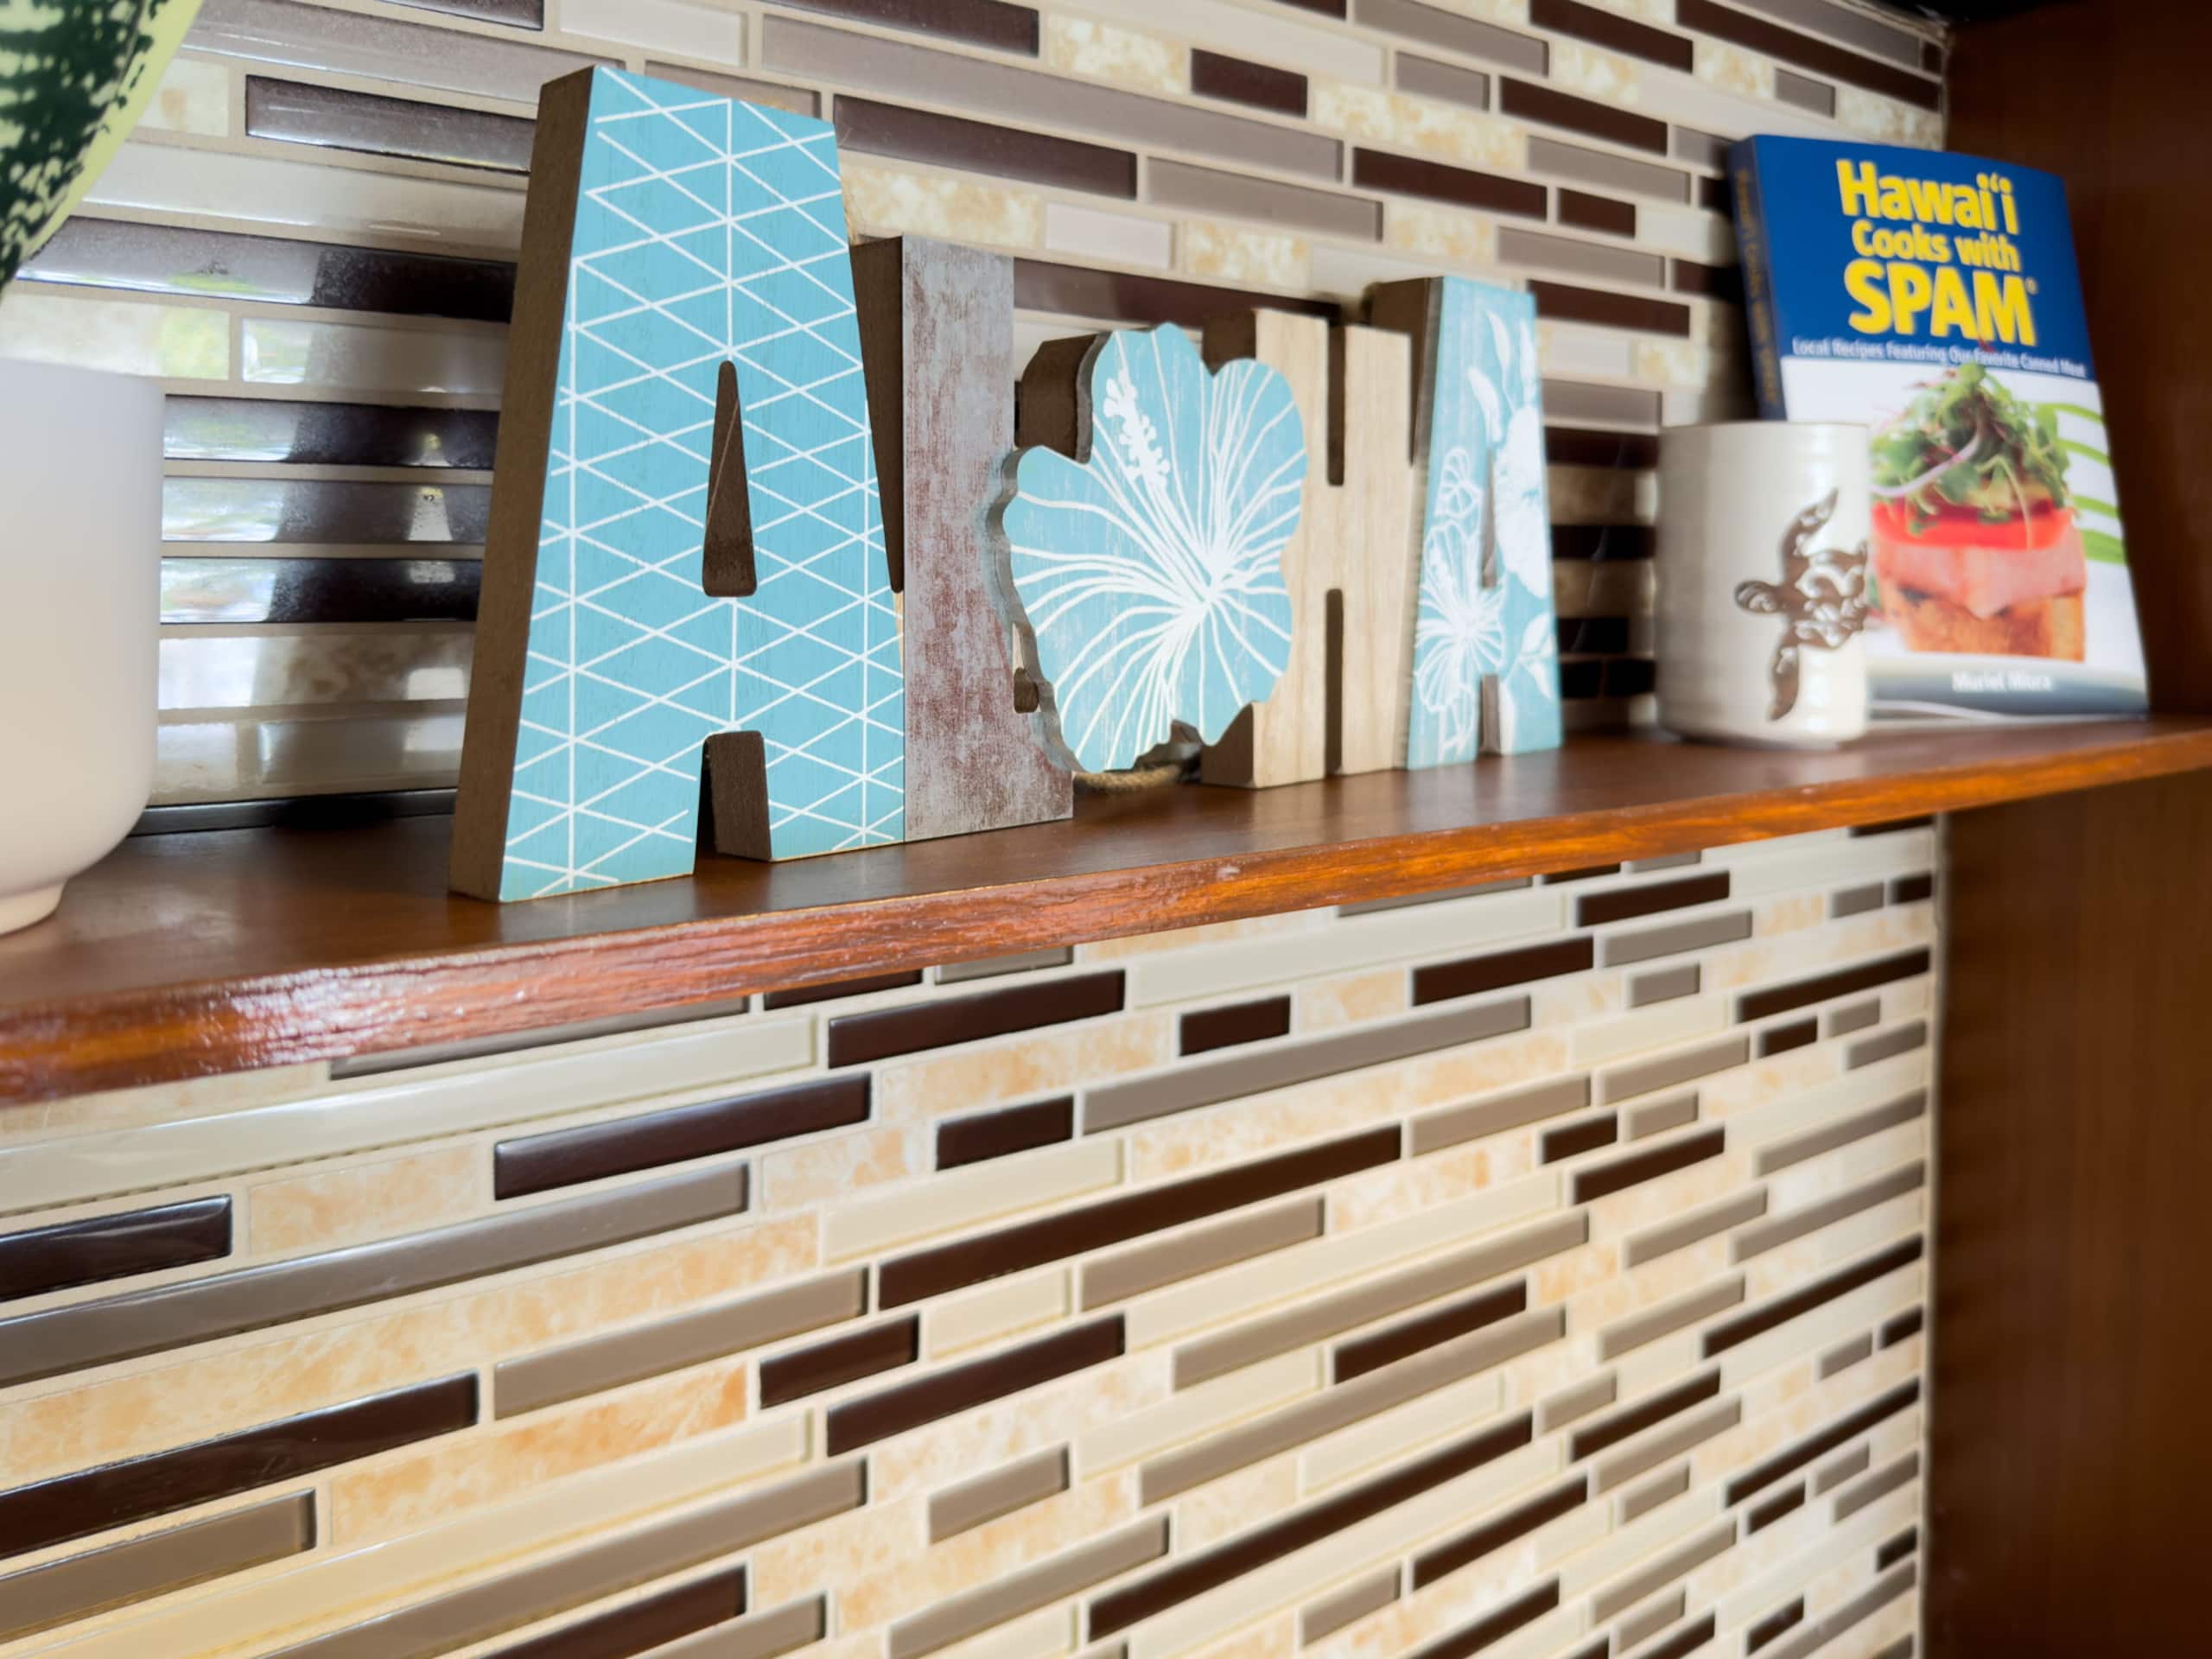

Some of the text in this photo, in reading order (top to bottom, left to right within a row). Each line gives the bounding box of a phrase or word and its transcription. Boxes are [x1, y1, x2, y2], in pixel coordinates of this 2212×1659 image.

[1852, 219, 2021, 272] Cooks with
[1792, 337, 1829, 356] Local
[1832, 339, 1883, 360] Recipes
[1886, 340, 1946, 363] Featuring
